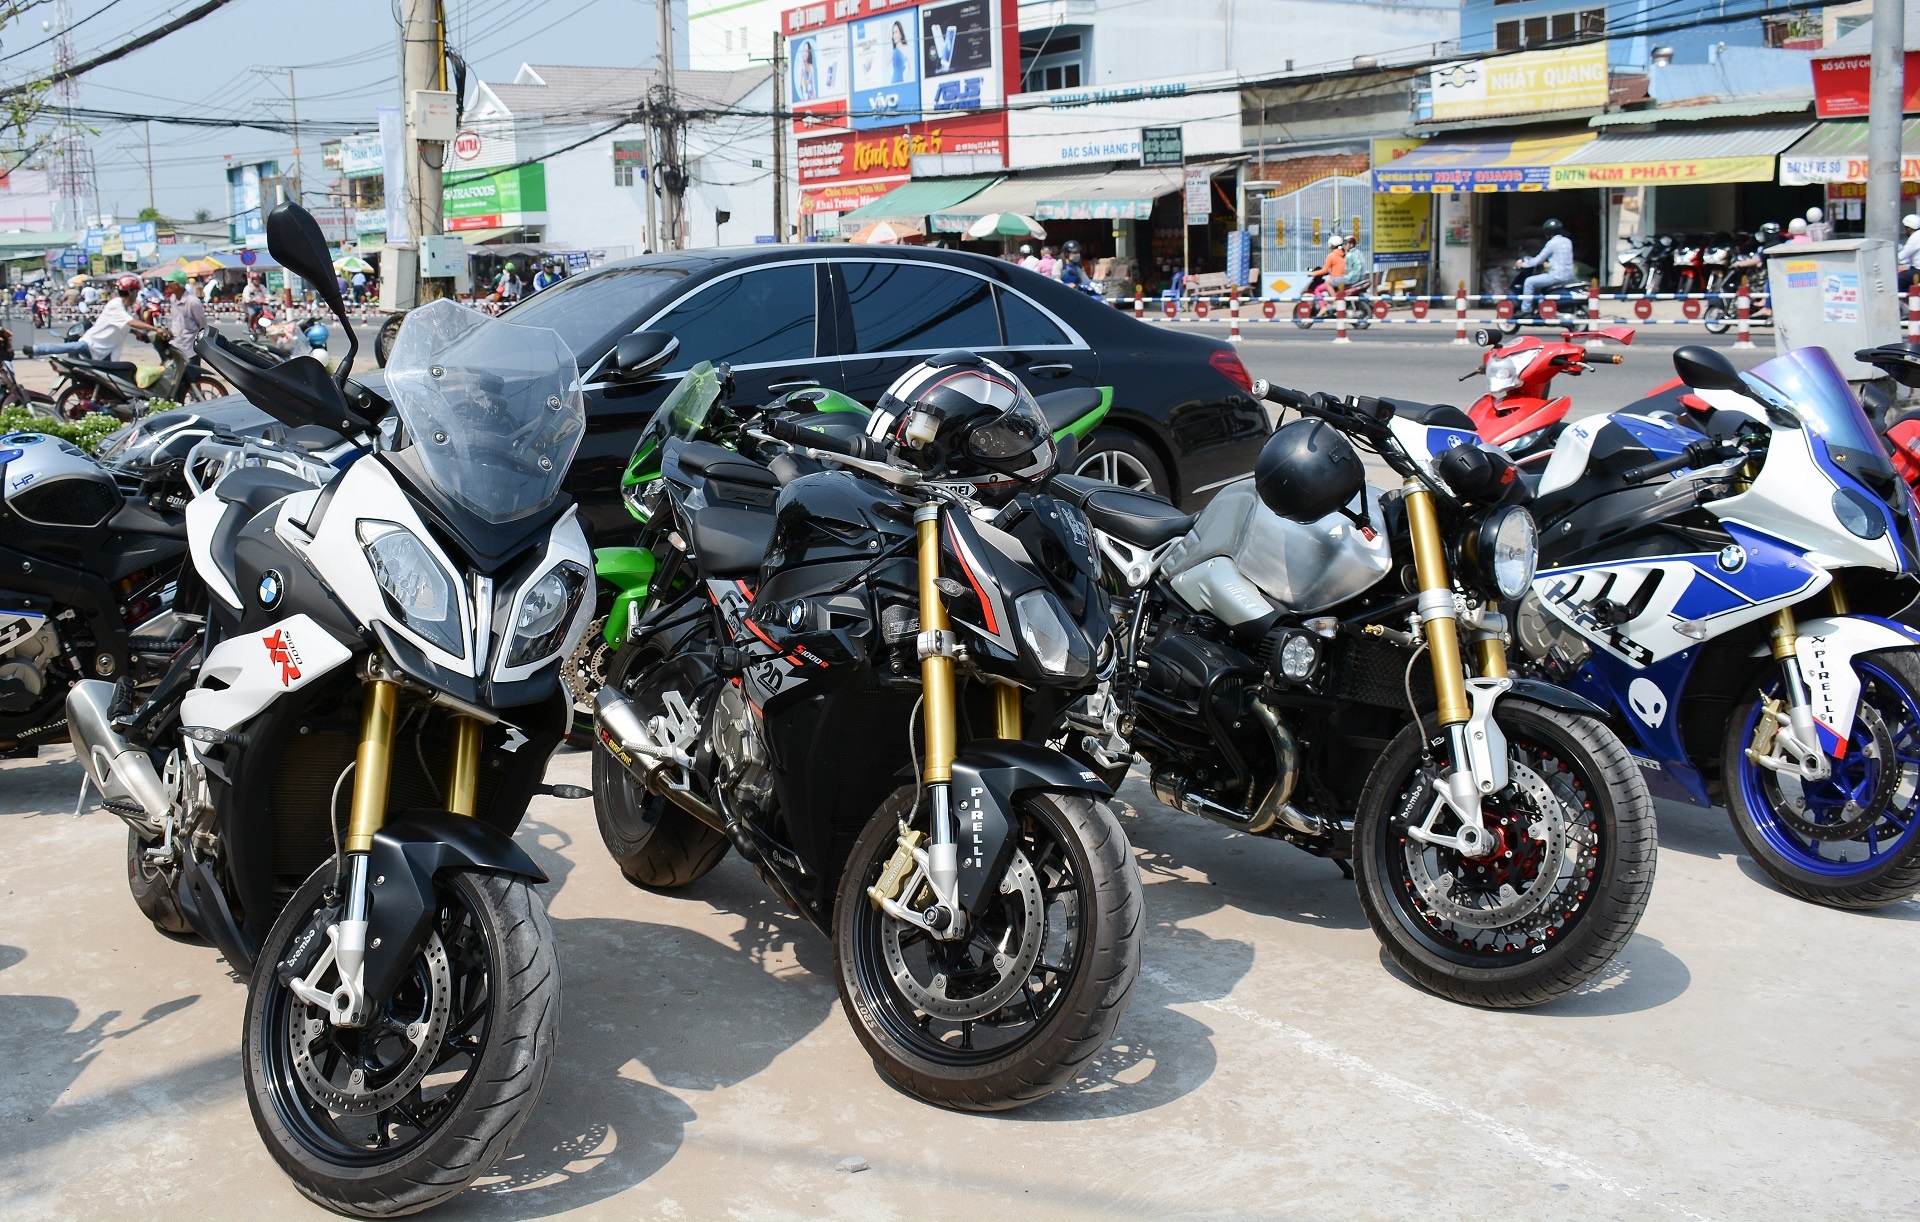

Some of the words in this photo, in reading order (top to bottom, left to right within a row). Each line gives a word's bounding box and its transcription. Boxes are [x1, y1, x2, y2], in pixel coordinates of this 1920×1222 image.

[934, 77, 982, 103] ASUS
[1491, 67, 1537, 92] NHẬT
[1543, 63, 1604, 88] QUANG
[1435, 169, 1473, 185] NHẬT
[1474, 169, 1523, 183] QUANG
[1555, 169, 1586, 181] DNTN
[1589, 168, 1624, 180] KIM
[1631, 163, 1681, 179] PHÁT
[443, 185, 496, 200] SATRAFOODS
[12, 473, 35, 490] HP
[262, 629, 302, 688] XR
[283, 630, 304, 666] S1000
[793, 644, 829, 669] S1000R
[1814, 650, 1835, 724] PIRELLI
[1401, 785, 1423, 819] brembo
[970, 787, 984, 868] PIRELLI
[286, 929, 316, 968] brembo
